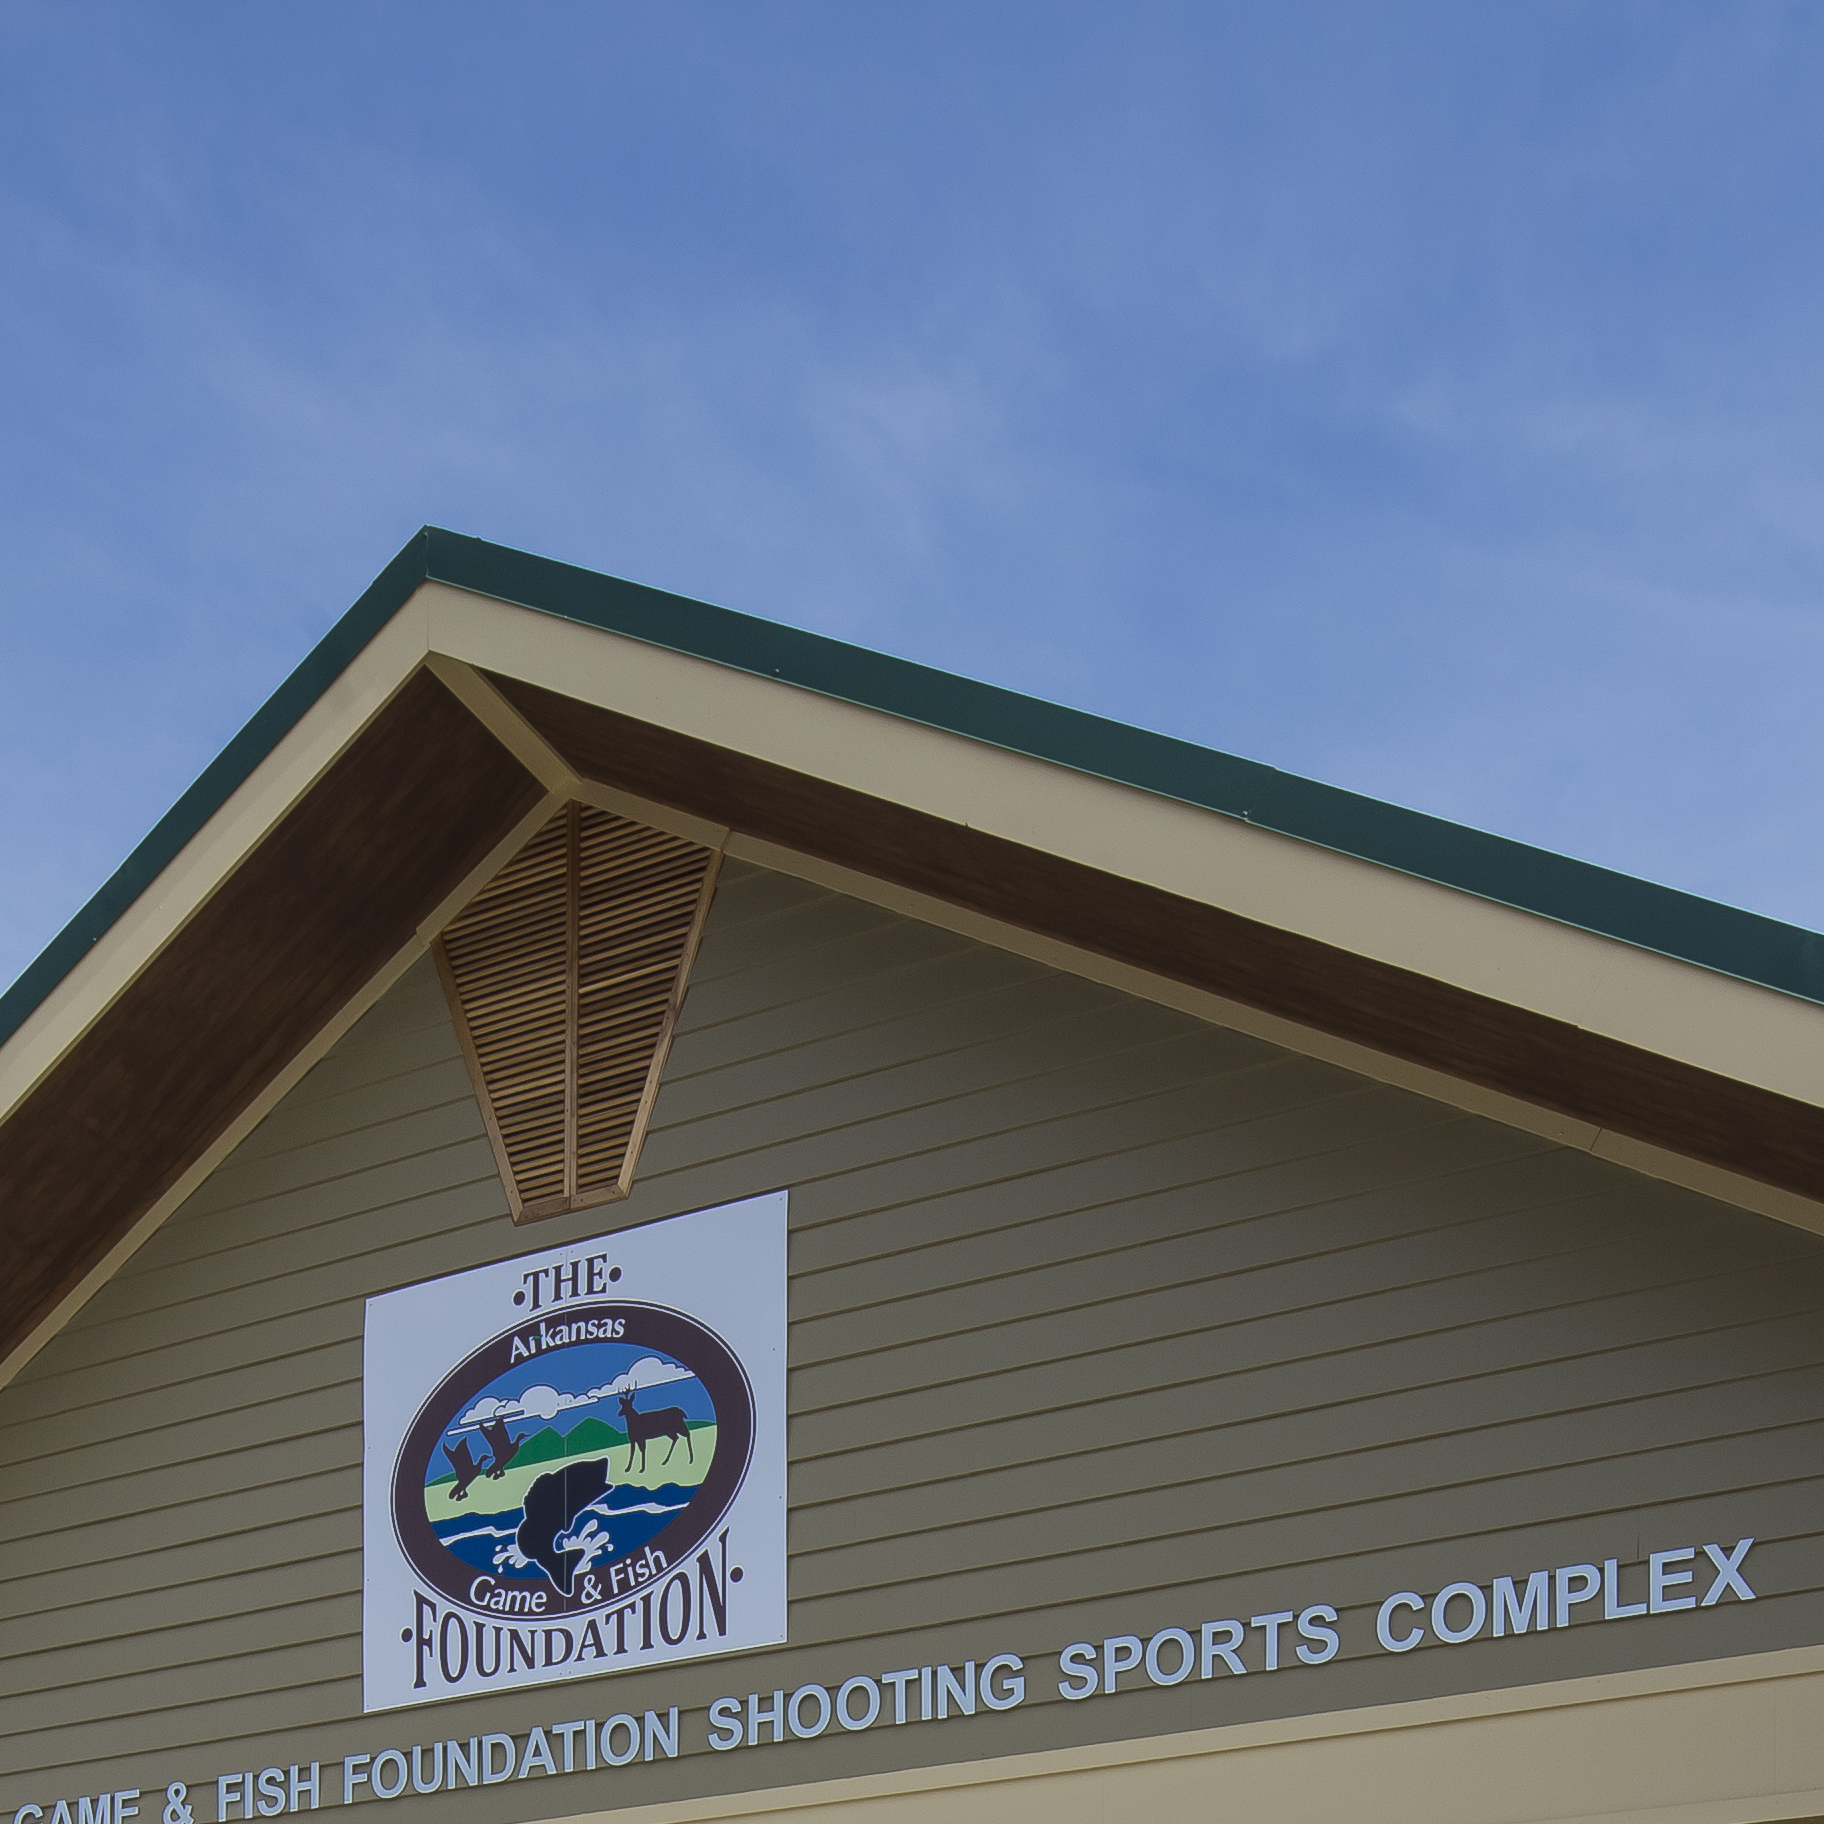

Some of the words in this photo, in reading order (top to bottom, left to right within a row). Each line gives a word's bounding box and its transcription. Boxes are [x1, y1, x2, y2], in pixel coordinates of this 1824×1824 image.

[522, 1252, 610, 1312] THE
[509, 1316, 626, 1363] Arkansas
[412, 1525, 730, 1689] FOUNDATION
[469, 1575, 547, 1613] Game
[580, 1575, 603, 1604] &
[609, 1545, 668, 1597] Fish
[217, 1761, 322, 1823] FISH
[342, 1705, 680, 1805] FOUNDATION
[707, 1652, 1027, 1751] SHOOTING
[1057, 1603, 1341, 1702] SPORTS
[1375, 1537, 1758, 1655] COMPLEX
